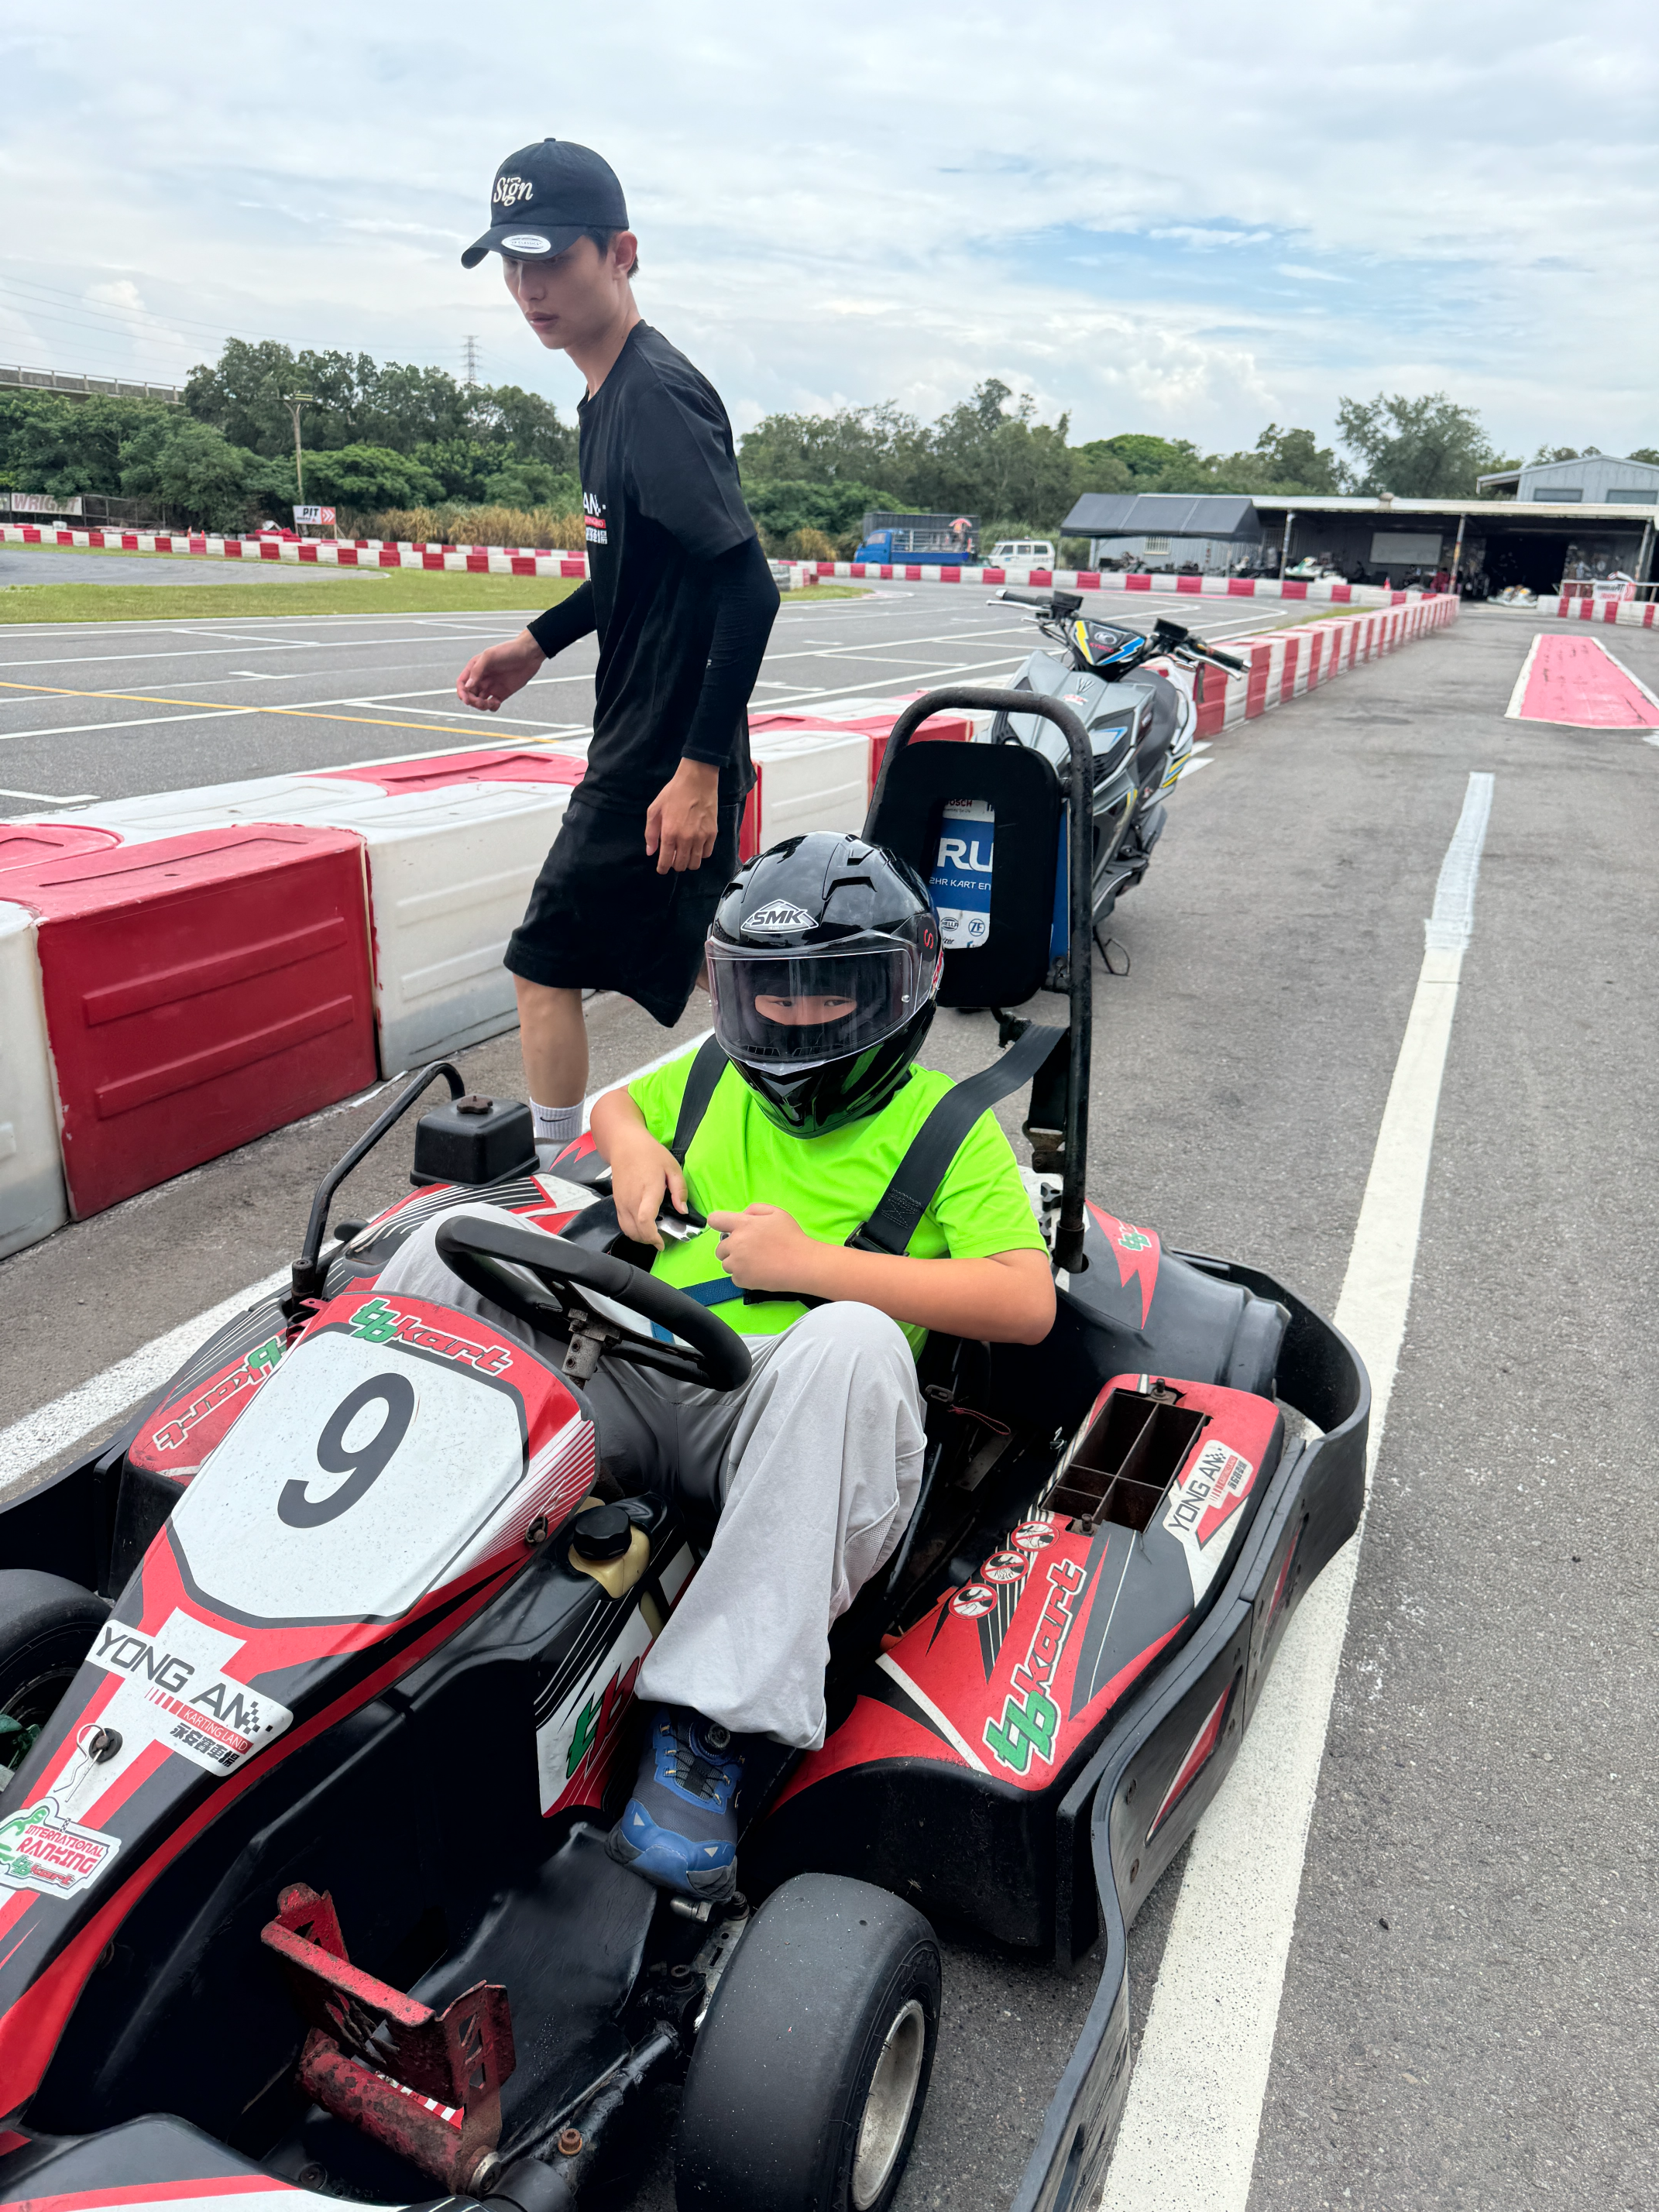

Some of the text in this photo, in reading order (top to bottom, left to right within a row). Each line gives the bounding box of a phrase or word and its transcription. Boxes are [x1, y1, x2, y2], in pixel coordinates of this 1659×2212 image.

[493, 177, 534, 206] Sign
[14, 495, 79, 513] WRIGT
[303, 507, 319, 517] PIT
[950, 880, 976, 888] KART
[750, 911, 806, 926] SMK
[970, 922, 984, 932] ZF
[277, 1372, 415, 1529] 9
[1168, 1455, 1225, 1531] YONG AN
[96, 1626, 254, 1733] YONG AN
[170, 1723, 240, 1767] 永安賽車場
[184, 1709, 248, 1751] KARTING LAND
[16, 1836, 98, 1874] RANKING
[25, 1825, 104, 1857] INTERNATIONAL
